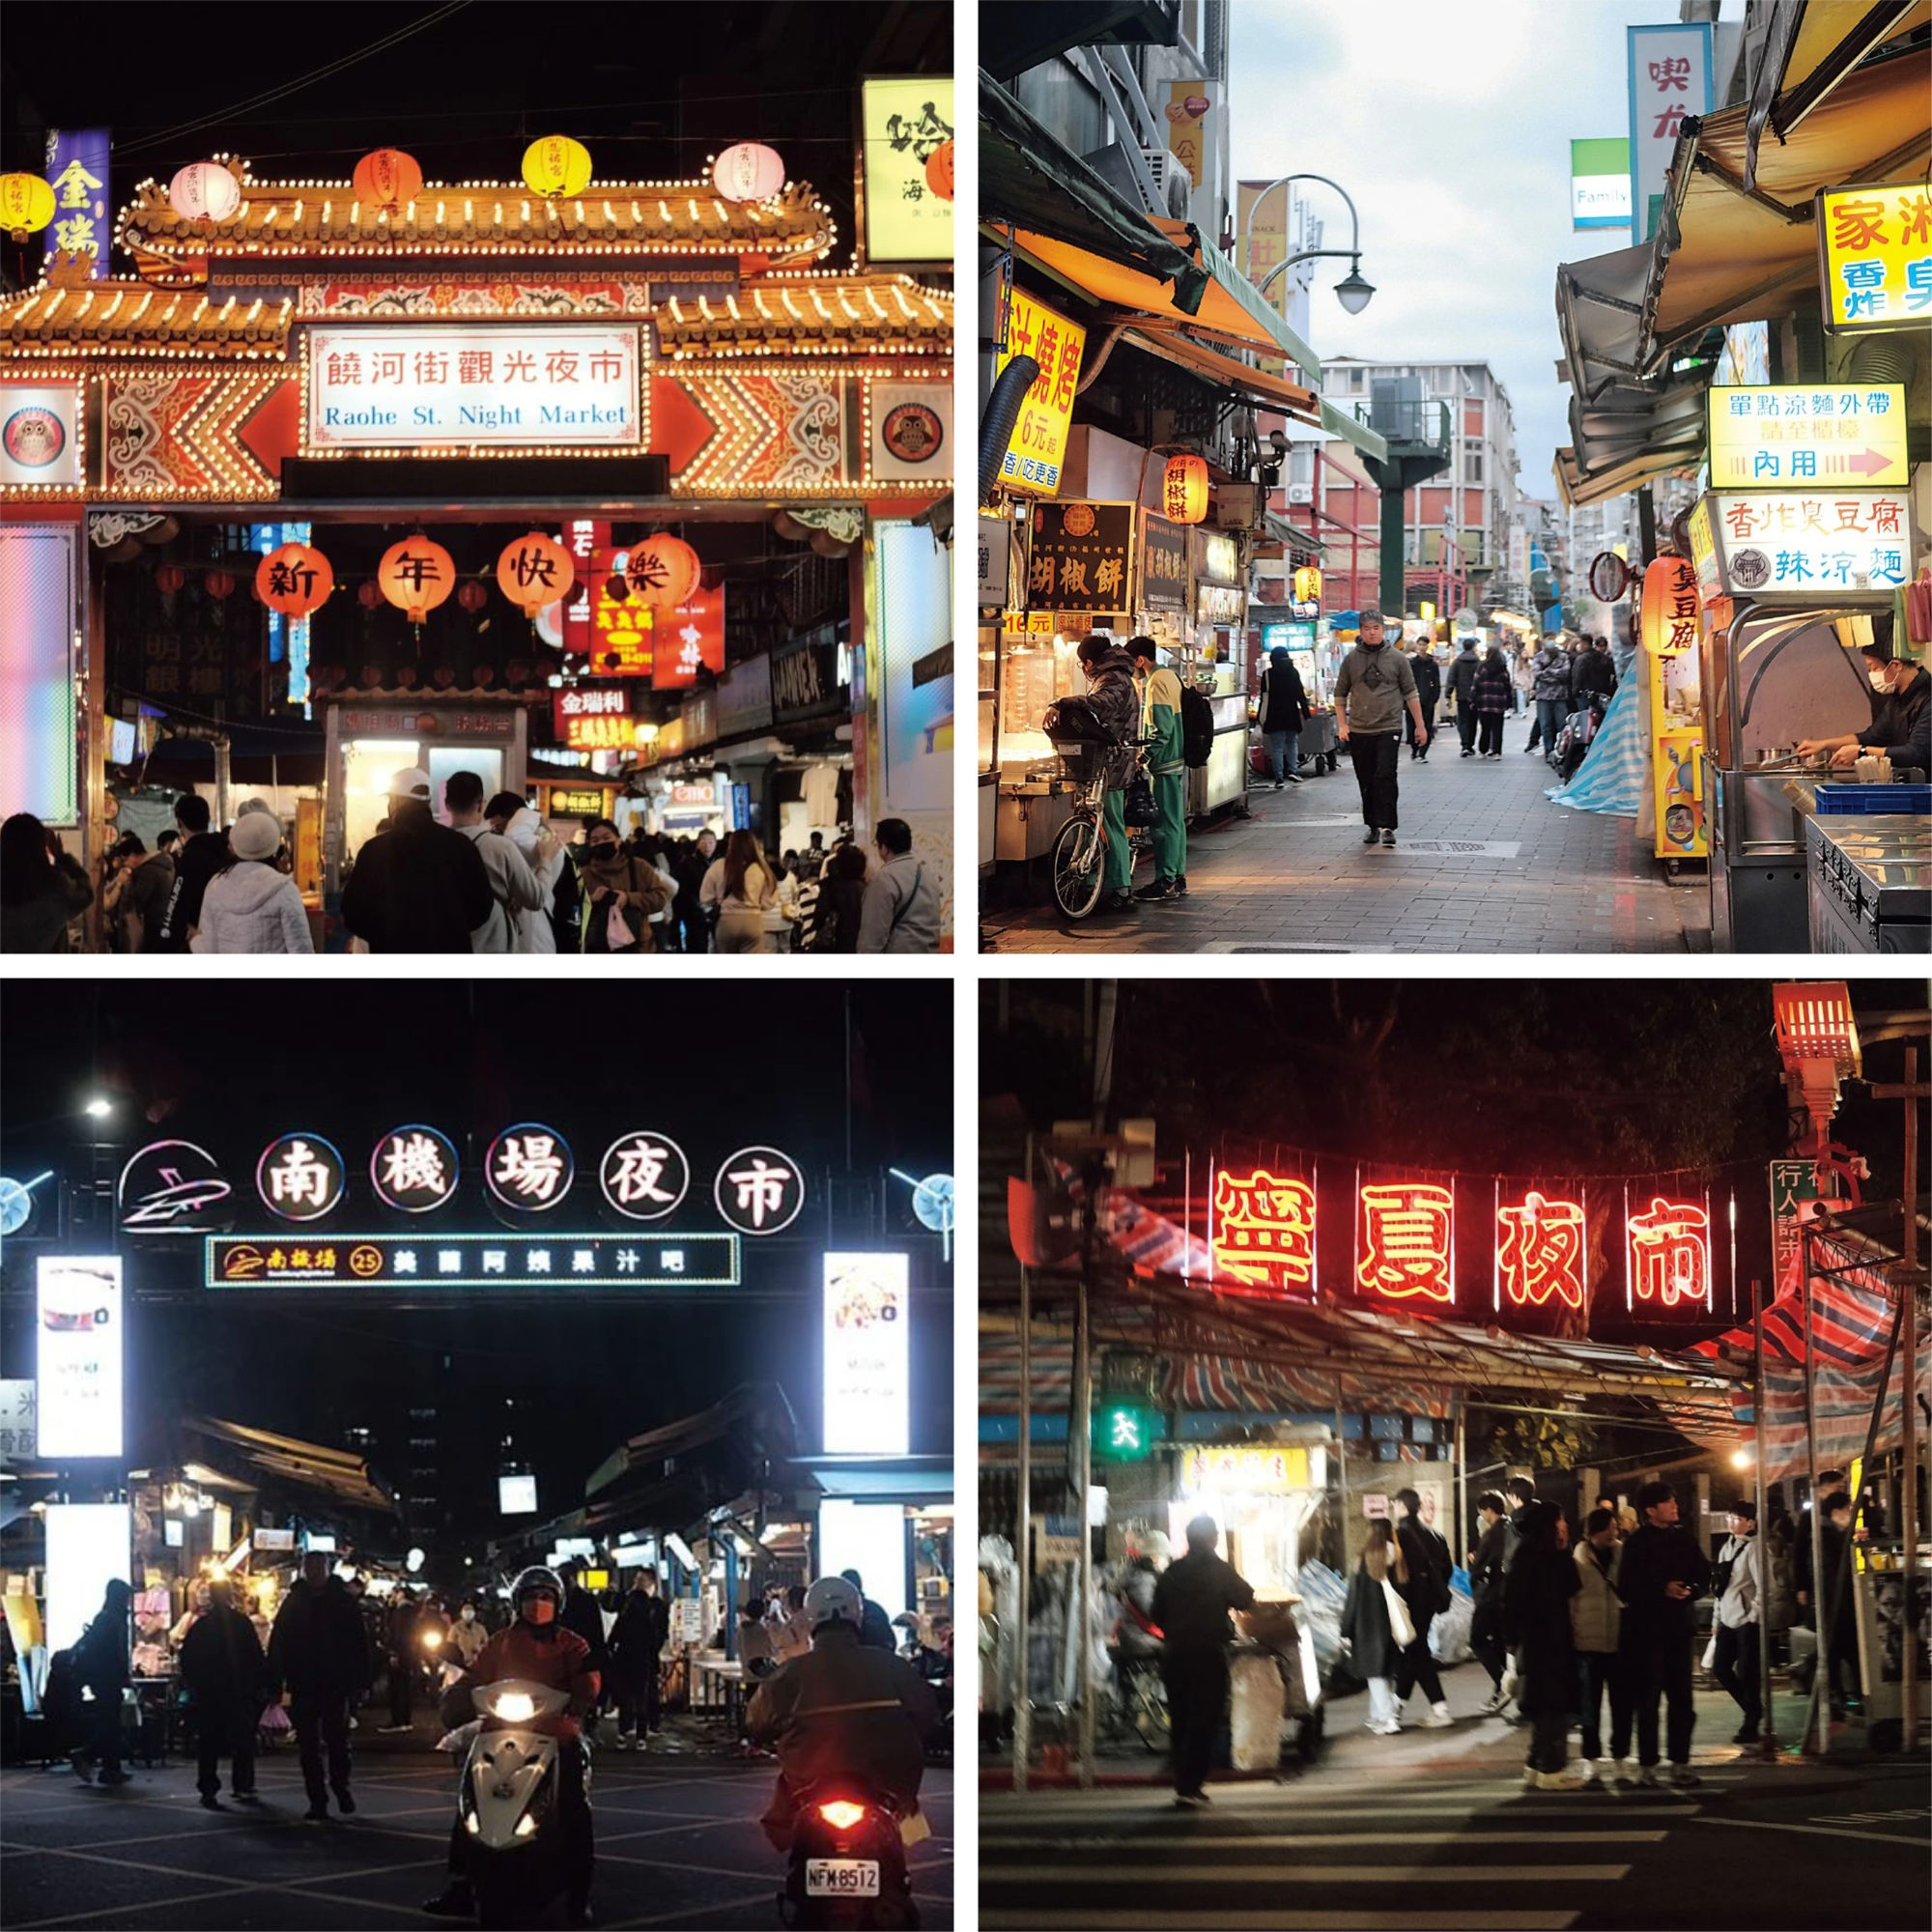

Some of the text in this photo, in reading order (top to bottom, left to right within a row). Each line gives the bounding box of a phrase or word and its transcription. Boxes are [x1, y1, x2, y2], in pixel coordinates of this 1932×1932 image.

[1577, 189, 1628, 204] Family
[327, 350, 624, 385] 饒河街觀光夜市
[1001, 298, 1081, 414] 汁燒烤
[326, 404, 627, 429] Raohe St. Night Market
[1729, 392, 1890, 416] 單點涼麵外帶
[1167, 469, 1188, 519] 胡椒餅
[1725, 497, 1905, 539] 香炸臭豆腐
[1031, 555, 1124, 600] 胡椒餅
[1776, 547, 1907, 584] 辣涼麵
[1665, 562, 1697, 651] 臭豆腐
[561, 690, 625, 714] 金瑞利
[270, 1132, 791, 1228] 南機場夜市
[1213, 1170, 1709, 1308] 寧夏夜市
[355, 1254, 377, 1270] 25
[808, 1868, 877, 1889] NFM-8512
